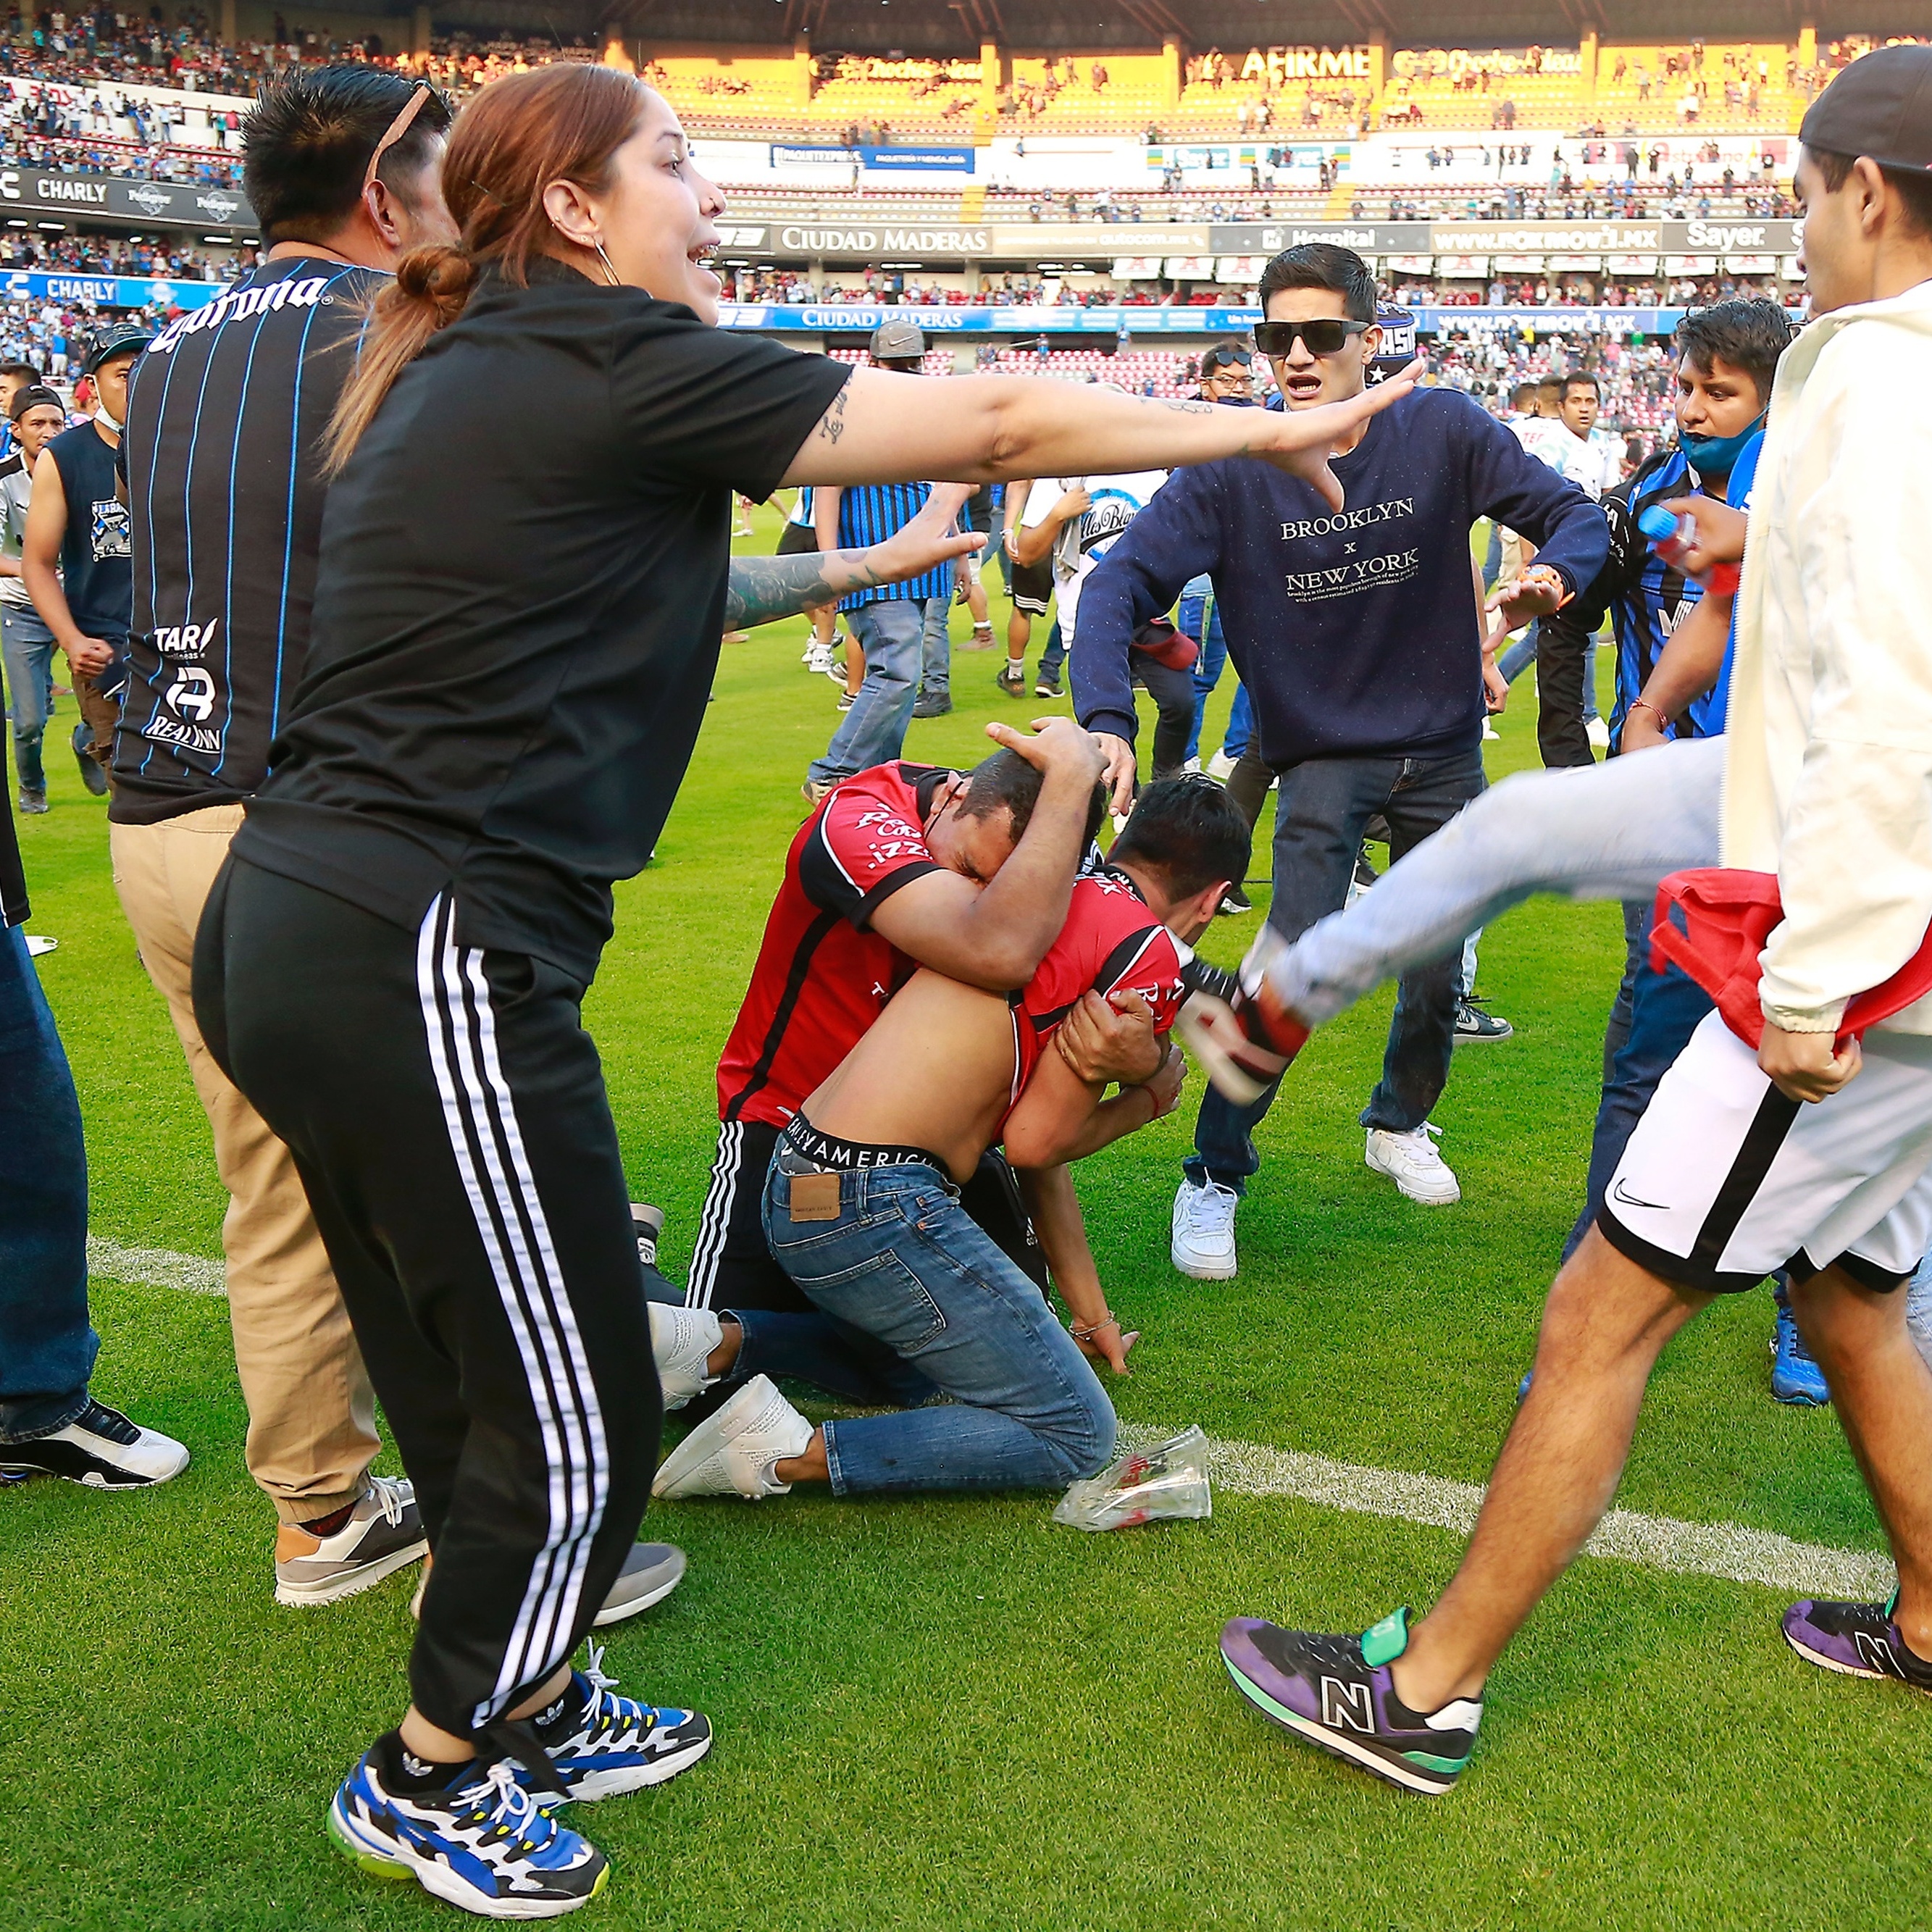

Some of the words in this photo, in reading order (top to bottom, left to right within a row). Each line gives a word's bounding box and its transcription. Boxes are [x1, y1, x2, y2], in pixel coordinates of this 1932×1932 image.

[38, 179, 107, 204] CHARLY
[782, 227, 882, 251] CIUDAD
[883, 230, 987, 251] MADERAS
[1292, 229, 1376, 248] Hospital
[46, 279, 116, 301] CHARLY
[147, 277, 328, 354] Corona
[801, 309, 877, 327] CIUDAD
[1281, 498, 1415, 540] BROOKLYN
[1285, 566, 1350, 590] NEW
[1352, 548, 1419, 578] YORK
[154, 624, 201, 652] TAR
[146, 715, 192, 744] REAL
[192, 724, 220, 750] INN
[1321, 1676, 1376, 1735] N
